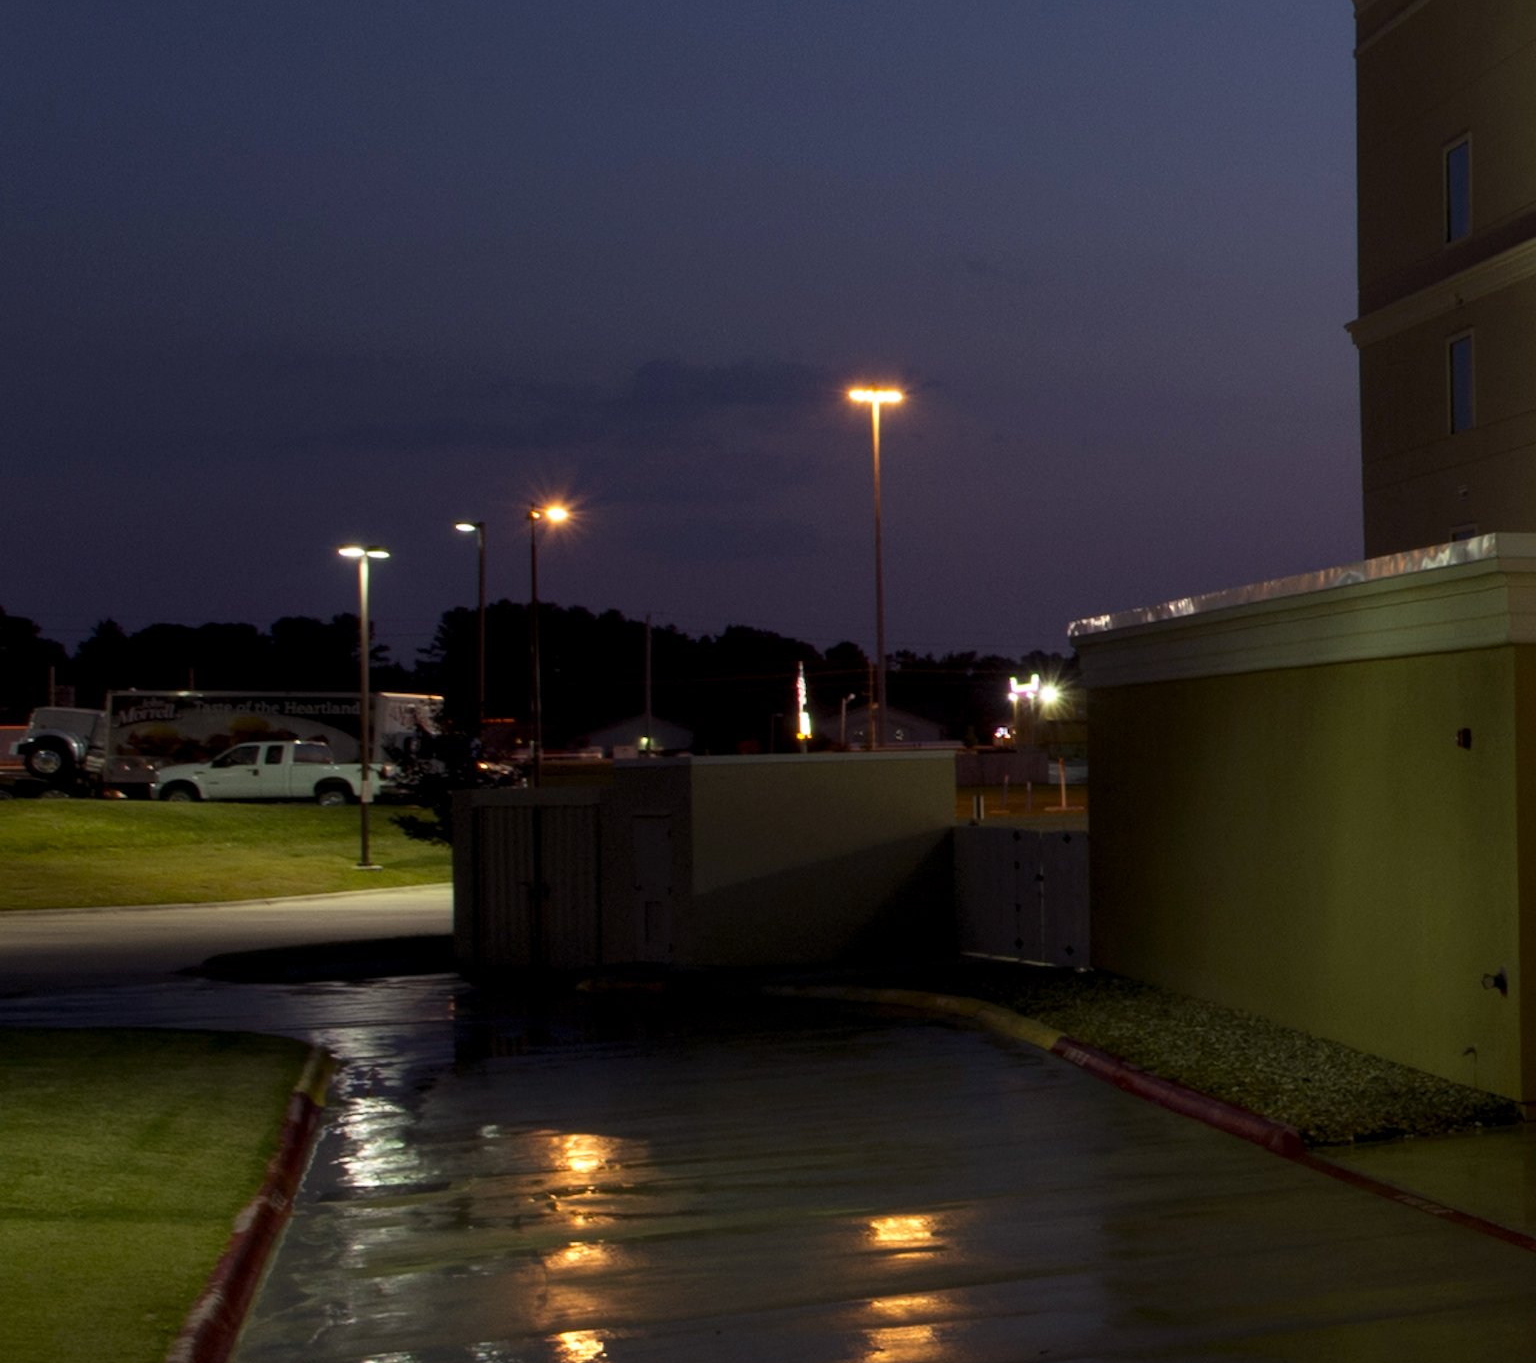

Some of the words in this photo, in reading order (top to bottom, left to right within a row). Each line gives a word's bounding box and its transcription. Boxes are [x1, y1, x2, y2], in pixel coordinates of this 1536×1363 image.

[235, 700, 253, 714] of
[252, 700, 281, 715] the
[284, 700, 361, 715] Heartland
